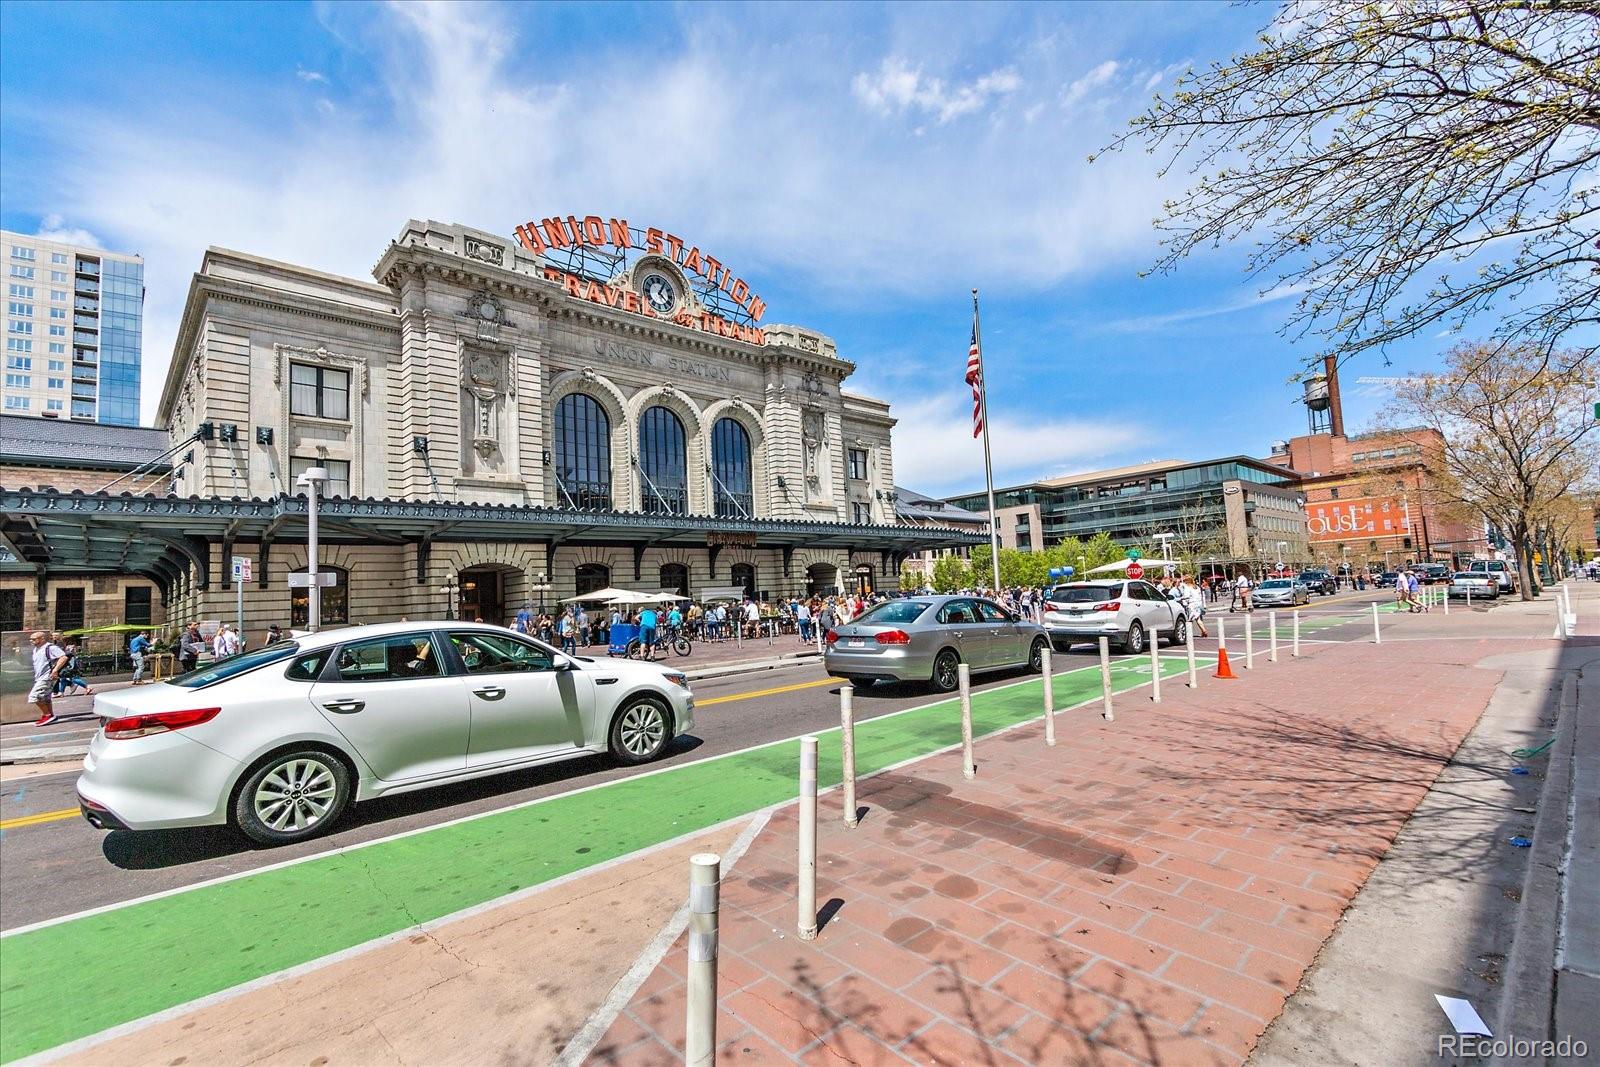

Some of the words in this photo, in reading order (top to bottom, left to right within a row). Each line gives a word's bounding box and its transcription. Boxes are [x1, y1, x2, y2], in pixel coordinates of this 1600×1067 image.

[515, 215, 631, 256] UNION
[646, 227, 767, 322] STATION
[543, 265, 658, 318] TRAVEL
[702, 312, 765, 346] TRAIN
[594, 340, 653, 367] UNION
[668, 357, 731, 381] STATION
[1127, 567, 1142, 575] STOP
